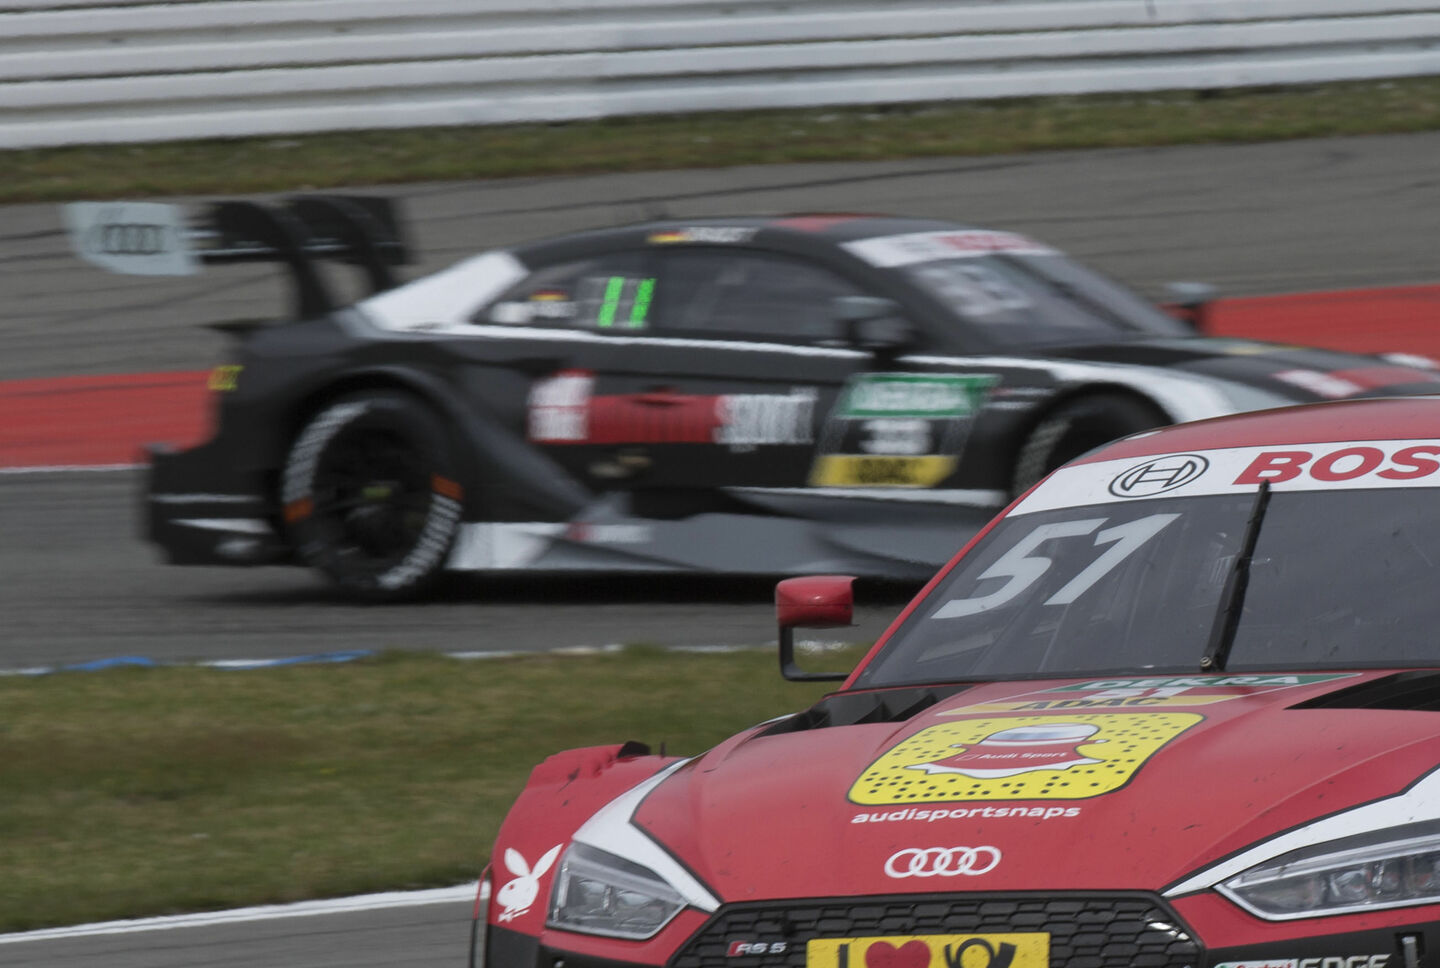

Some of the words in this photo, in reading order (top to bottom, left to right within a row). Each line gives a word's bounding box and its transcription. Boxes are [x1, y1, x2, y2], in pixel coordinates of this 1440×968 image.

[931, 512, 1181, 619] 51
[1080, 675, 1298, 690] DEKRA
[1010, 696, 1169, 711] ADAC
[978, 752, 1017, 760] Audi
[1021, 751, 1068, 760] Sport
[851, 806, 1081, 824] audisportsnaps
